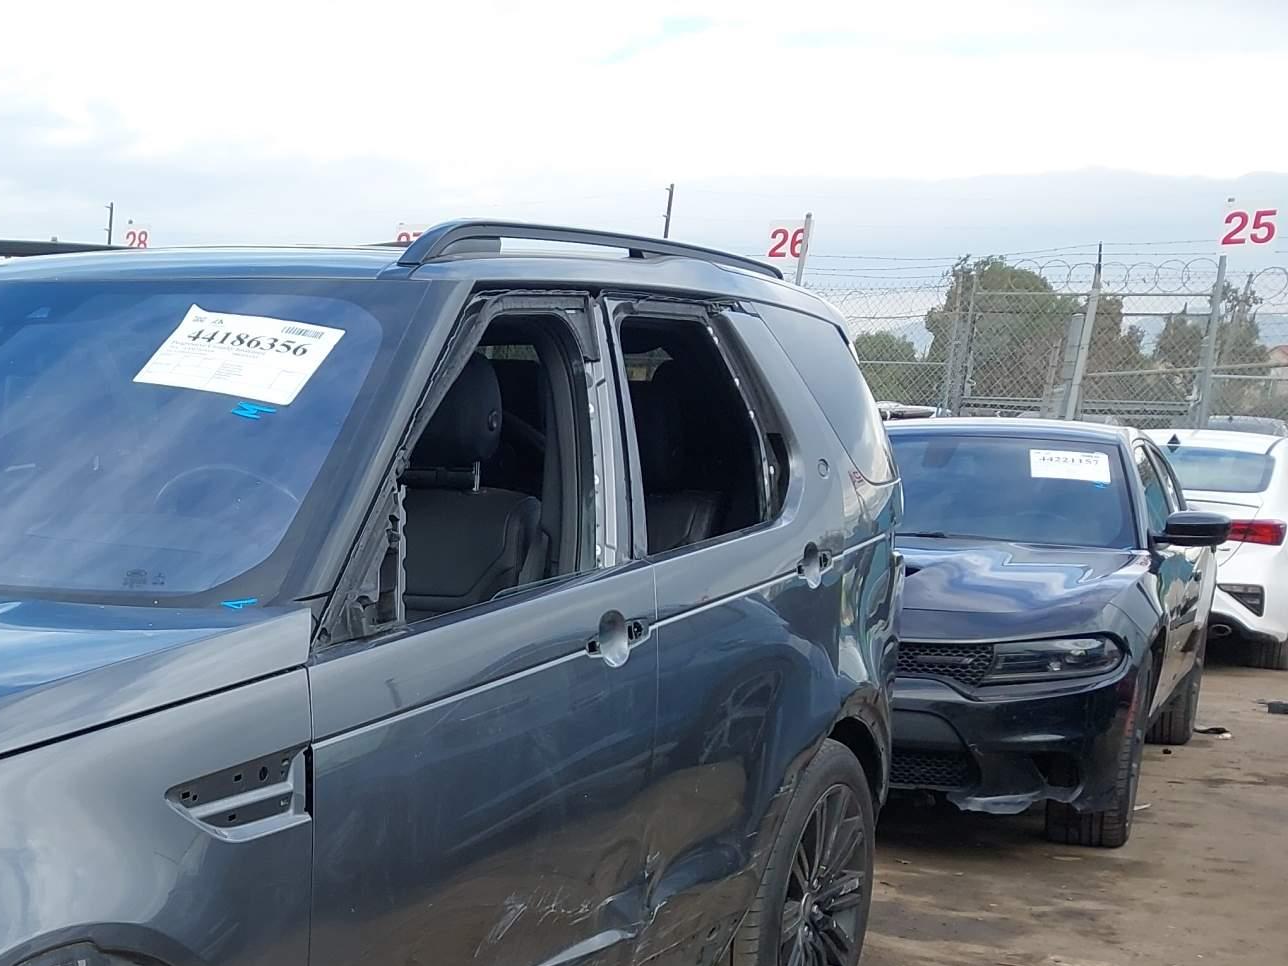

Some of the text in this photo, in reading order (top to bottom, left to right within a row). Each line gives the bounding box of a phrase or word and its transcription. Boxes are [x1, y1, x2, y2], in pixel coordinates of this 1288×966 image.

[126, 230, 148, 249] 28
[1221, 210, 1277, 245] 25
[768, 228, 808, 257] 26
[187, 328, 312, 357] 44186356
